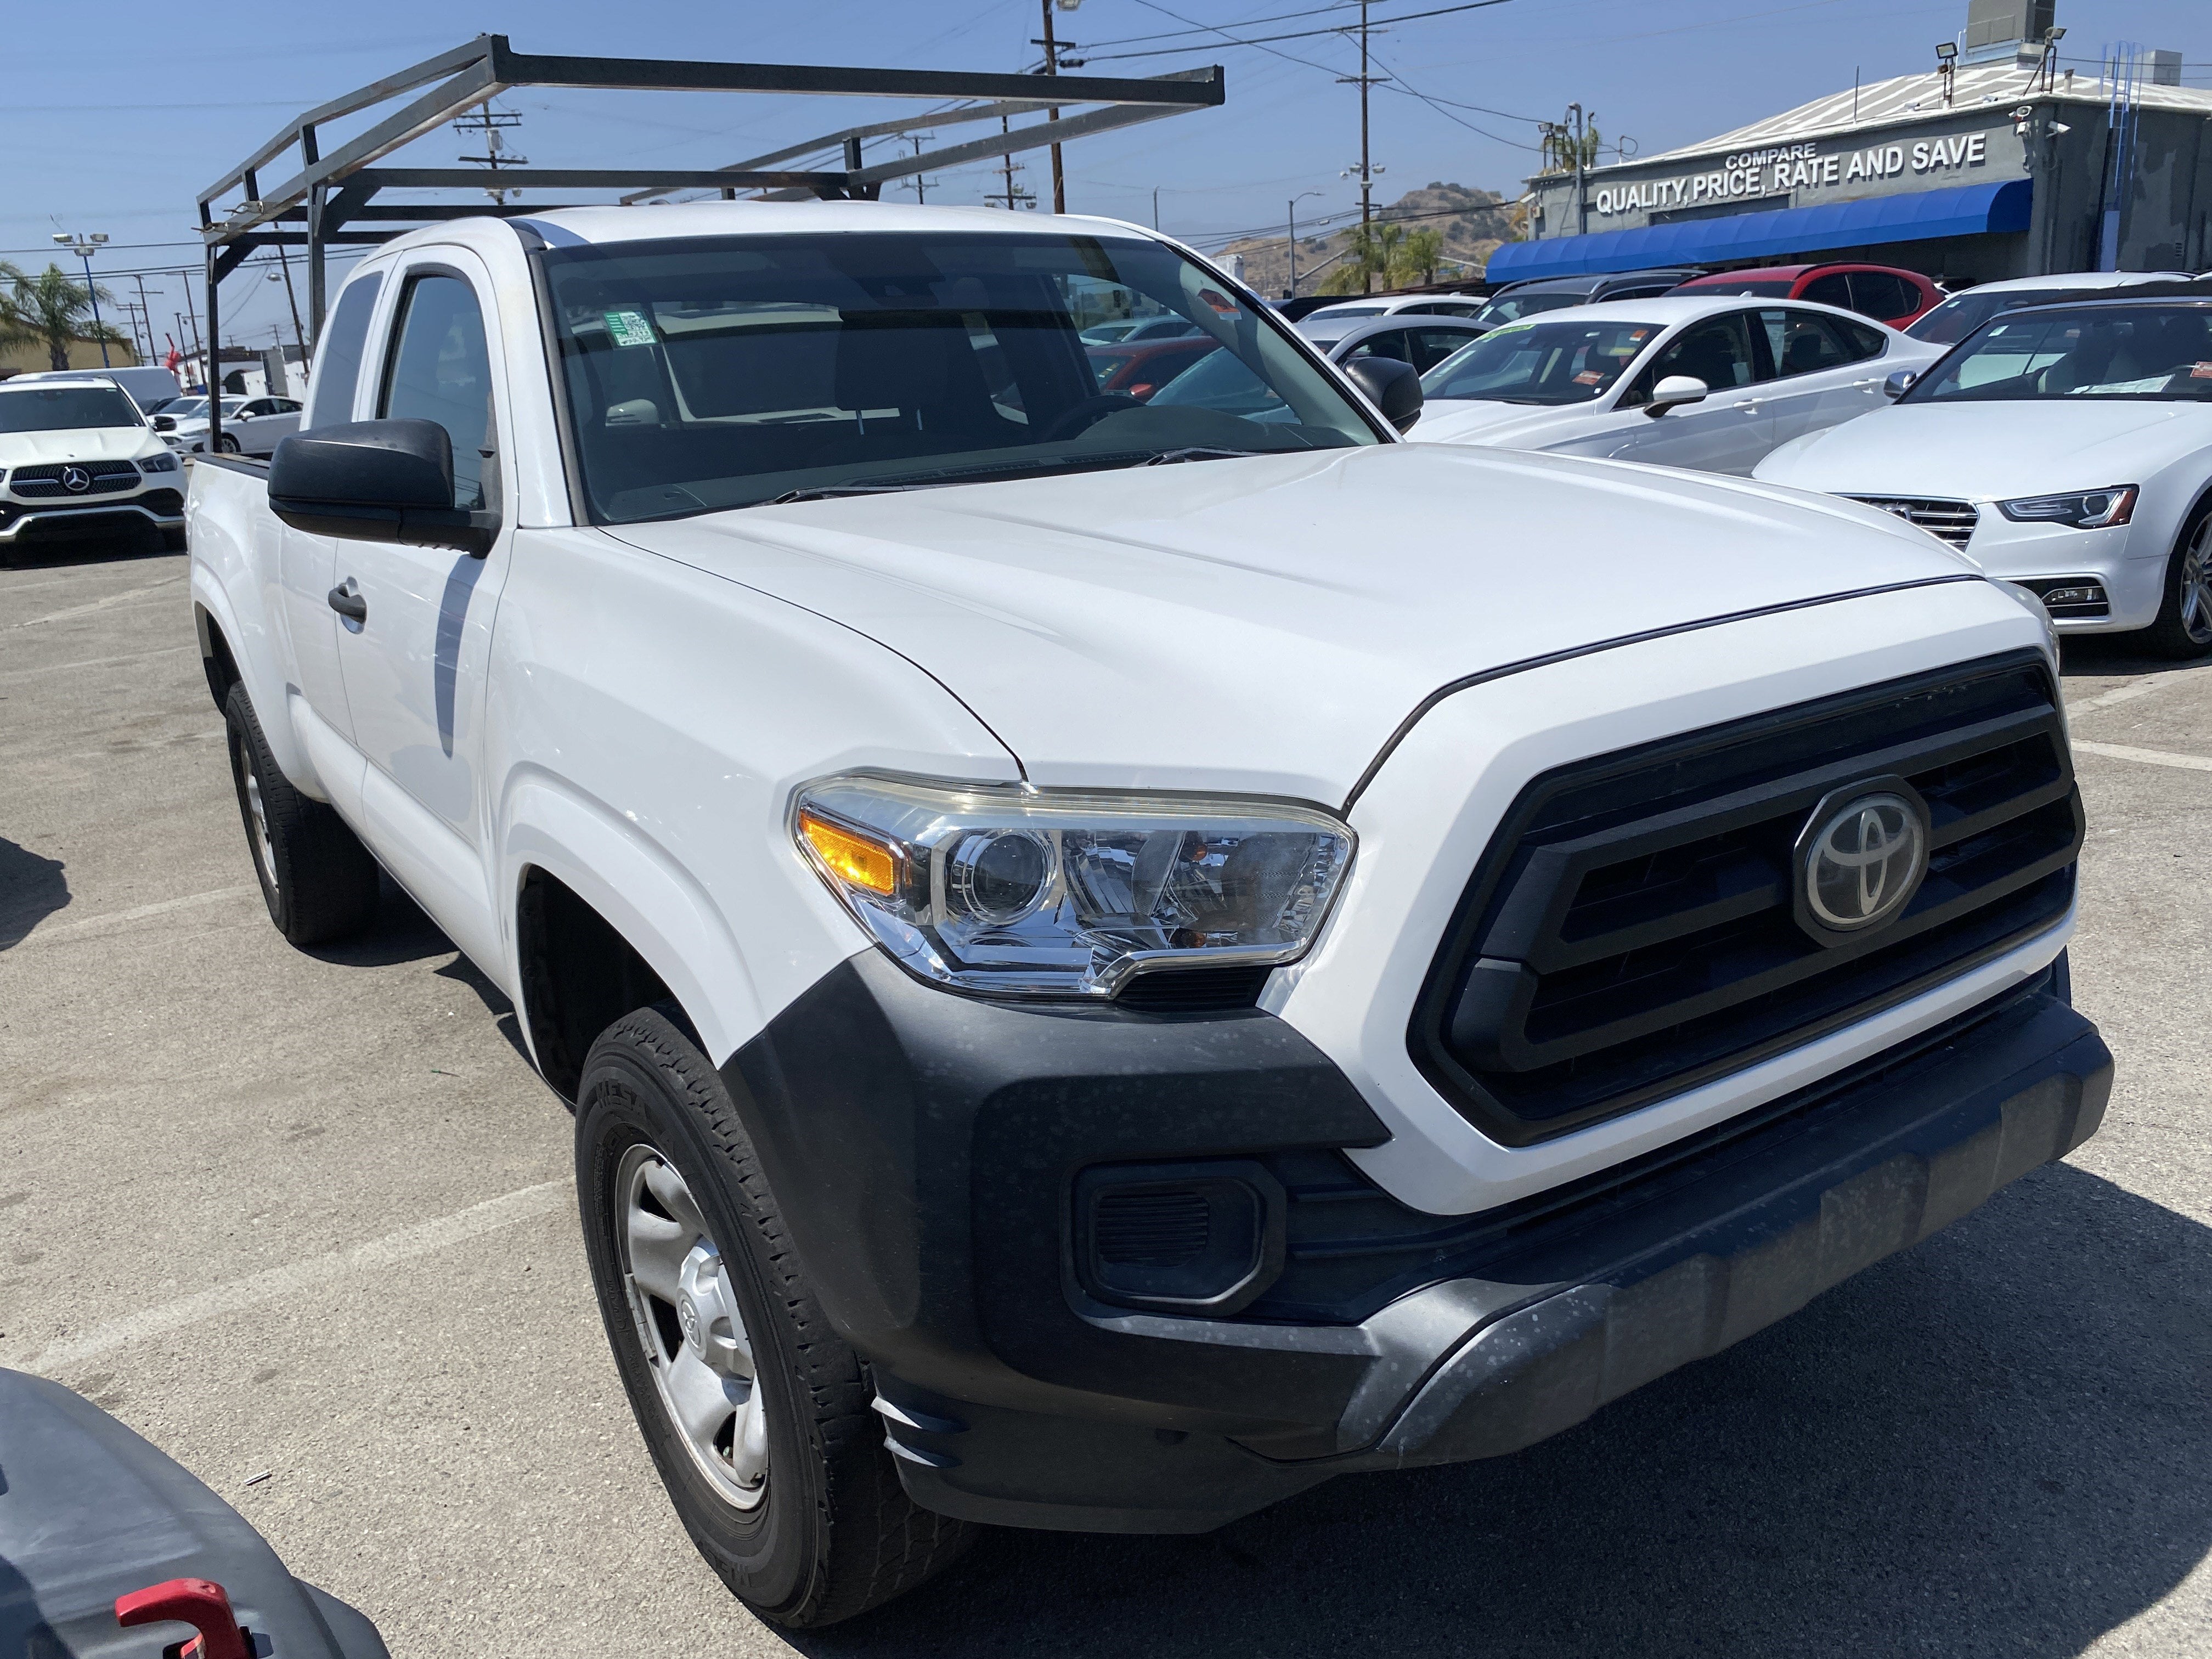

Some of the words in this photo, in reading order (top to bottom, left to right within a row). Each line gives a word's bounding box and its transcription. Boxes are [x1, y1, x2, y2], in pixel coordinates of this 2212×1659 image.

[1596, 178, 1688, 213] QUALITY,
[1693, 167, 1766, 200] PRICE,
[1774, 155, 1840, 189] RATE
[1846, 146, 1903, 179] AND
[1911, 133, 1985, 170] SAVE
[1725, 142, 1816, 170] COMPARE
